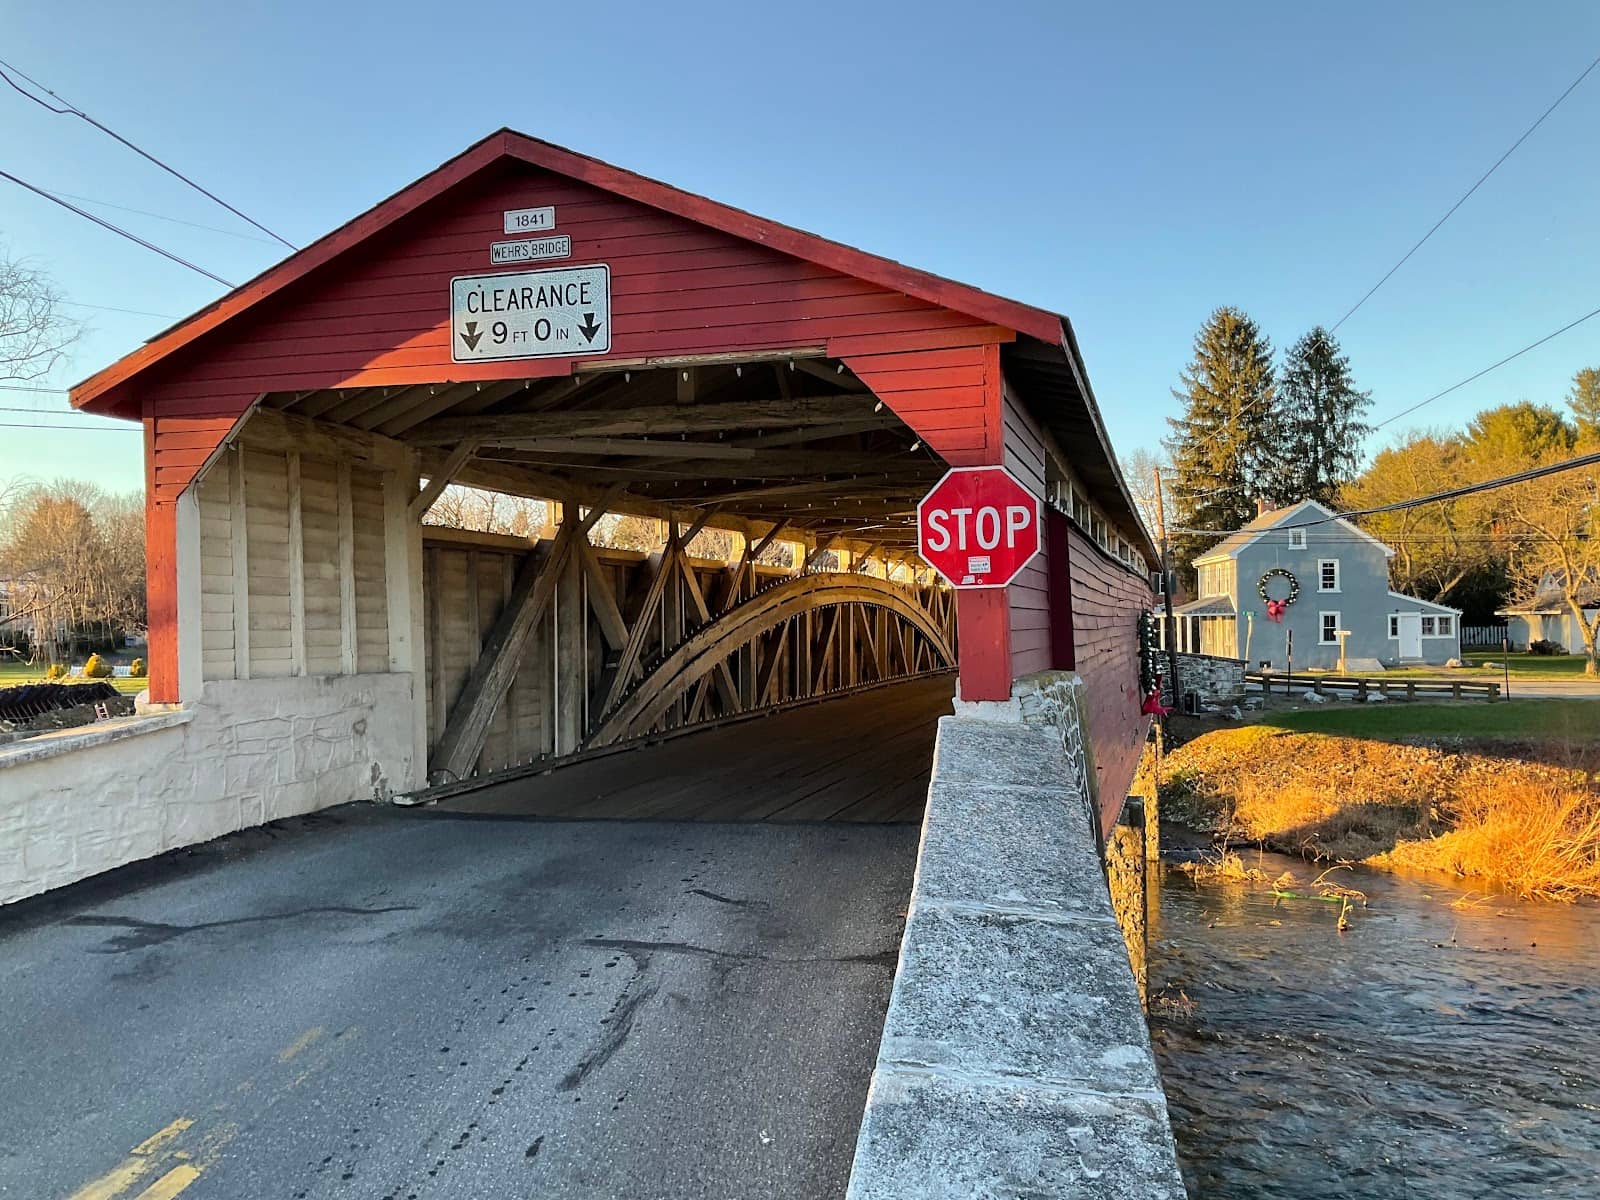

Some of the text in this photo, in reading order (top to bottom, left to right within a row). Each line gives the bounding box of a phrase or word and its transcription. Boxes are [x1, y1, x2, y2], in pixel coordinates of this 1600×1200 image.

[515, 213, 544, 227] 1841
[493, 240, 568, 259] WEHR'S BRIDGE
[467, 282, 592, 313] CLEARANCE
[492, 318, 569, 344] 9 FT 0 IN
[927, 506, 1031, 552] STOP
